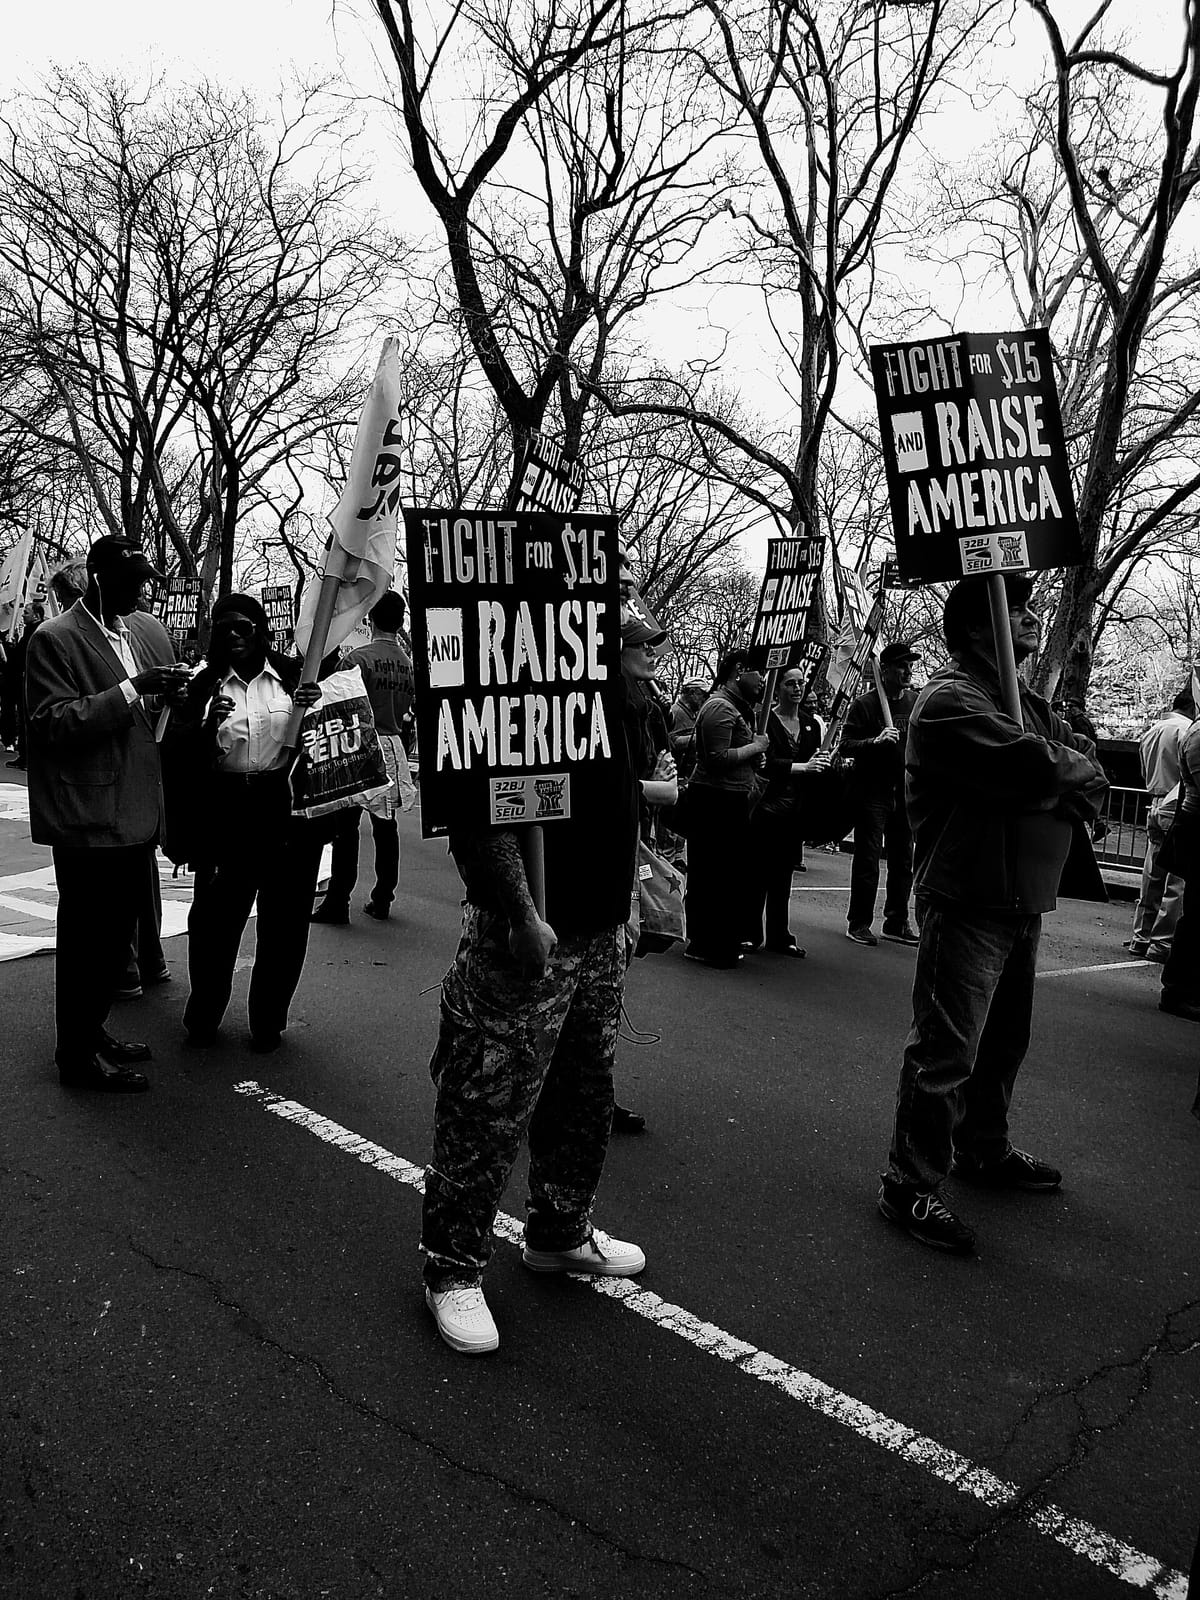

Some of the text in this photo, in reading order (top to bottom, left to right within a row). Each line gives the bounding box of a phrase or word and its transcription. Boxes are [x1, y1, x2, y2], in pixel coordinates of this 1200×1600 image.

[883, 338, 1042, 397] FIGHT FOR $15
[896, 395, 1052, 468] AND RAISE
[532, 432, 563, 471] FIGHT
[536, 469, 578, 513] RAISE
[908, 465, 1063, 536] AMERICA
[422, 518, 607, 590] FIGHT FOR $15
[771, 541, 801, 569] FIGHT
[963, 537, 989, 549] 32BJ
[967, 558, 992, 570] SEIU
[174, 594, 199, 612] RAISE
[271, 600, 291, 617] RAISE
[776, 573, 818, 611] RAISE
[431, 634, 461, 664] AND
[477, 601, 608, 686] RAISE
[754, 611, 807, 646] AMERICA
[436, 691, 611, 772] AMERICA
[495, 780, 526, 792] 32BJ
[496, 807, 526, 817] SEIU
